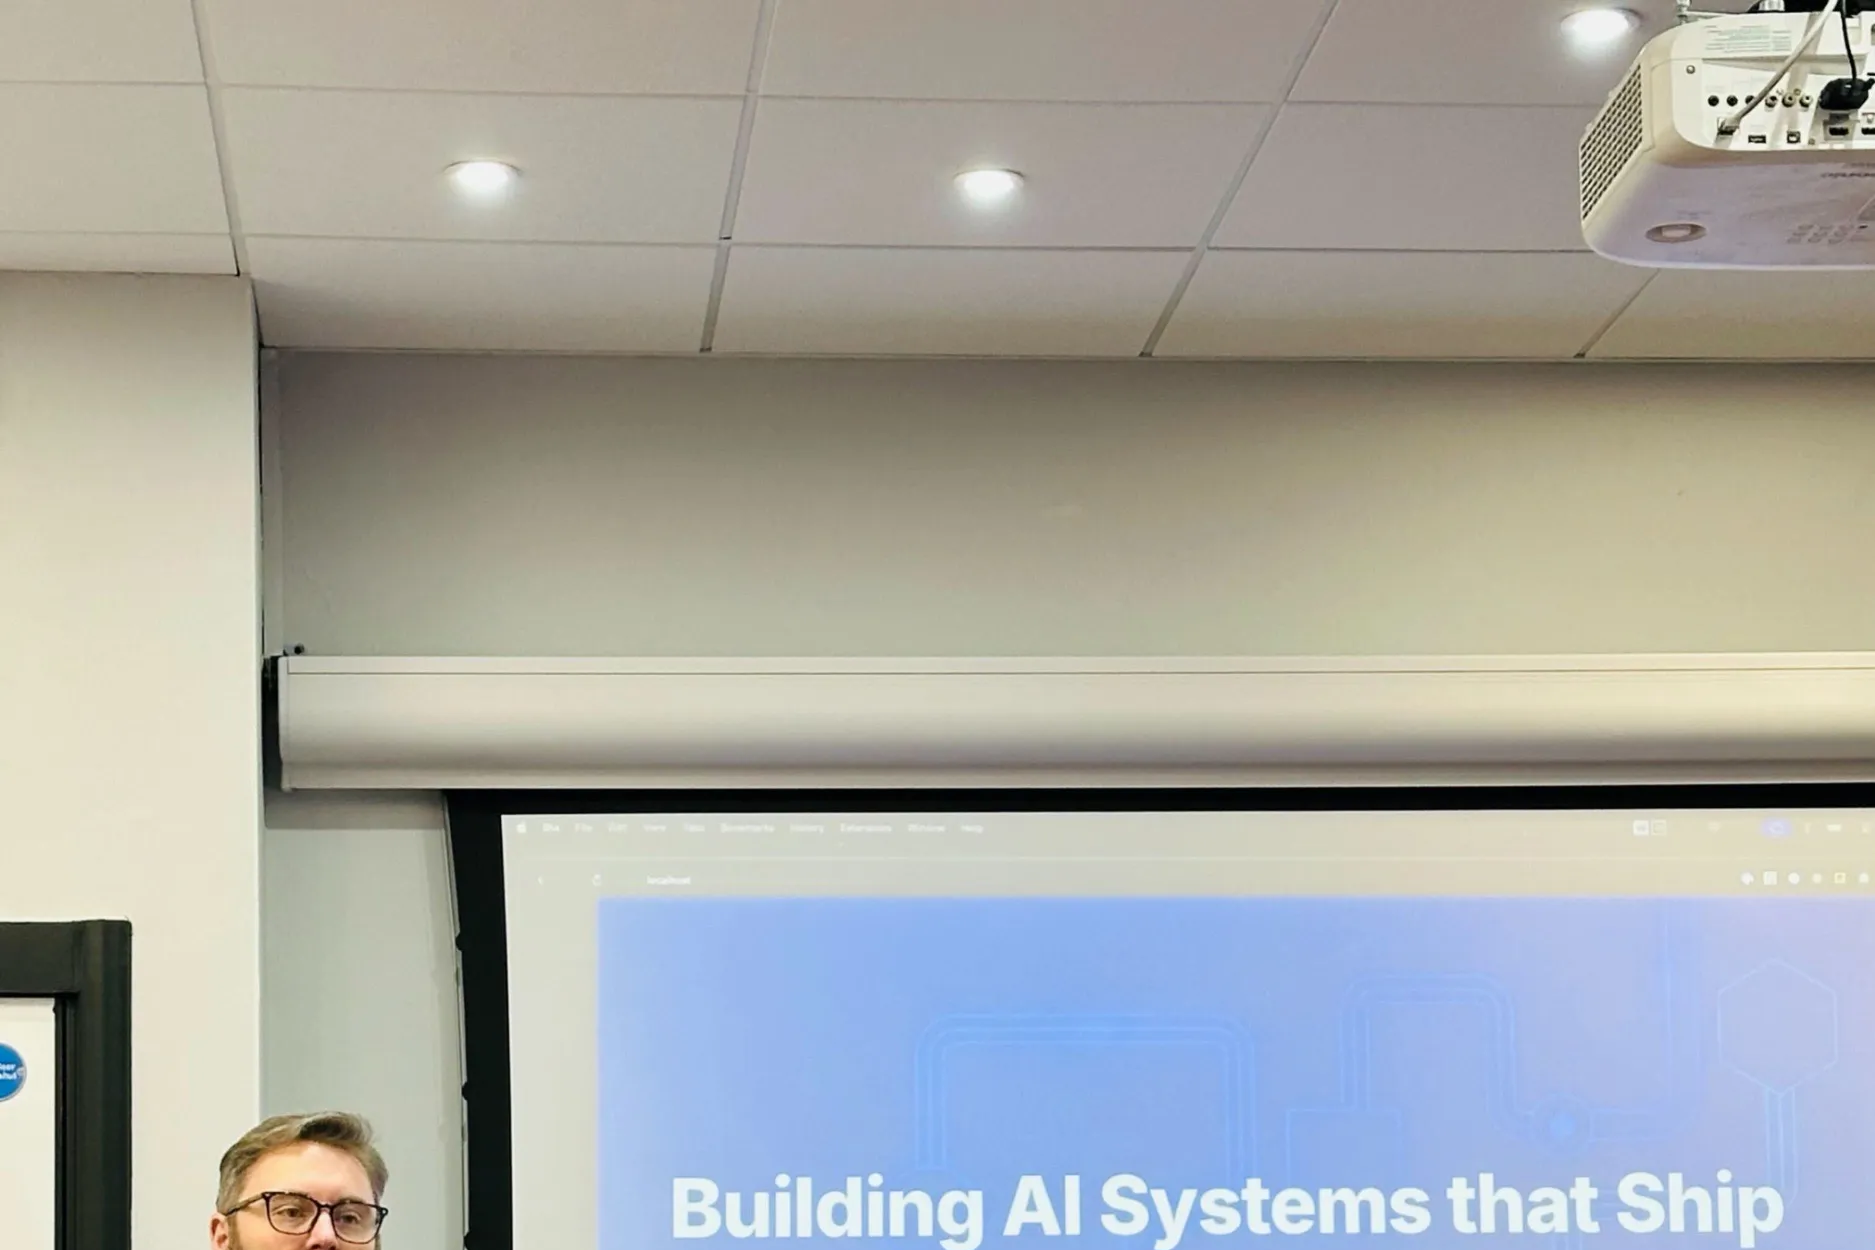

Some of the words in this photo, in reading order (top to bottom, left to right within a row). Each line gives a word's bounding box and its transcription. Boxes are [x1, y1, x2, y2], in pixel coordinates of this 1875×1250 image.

[646, 875, 692, 886] localhost
[1003, 1174, 1081, 1236] AI
[1446, 1172, 1601, 1234] that
[1616, 1168, 1784, 1249] Ship
